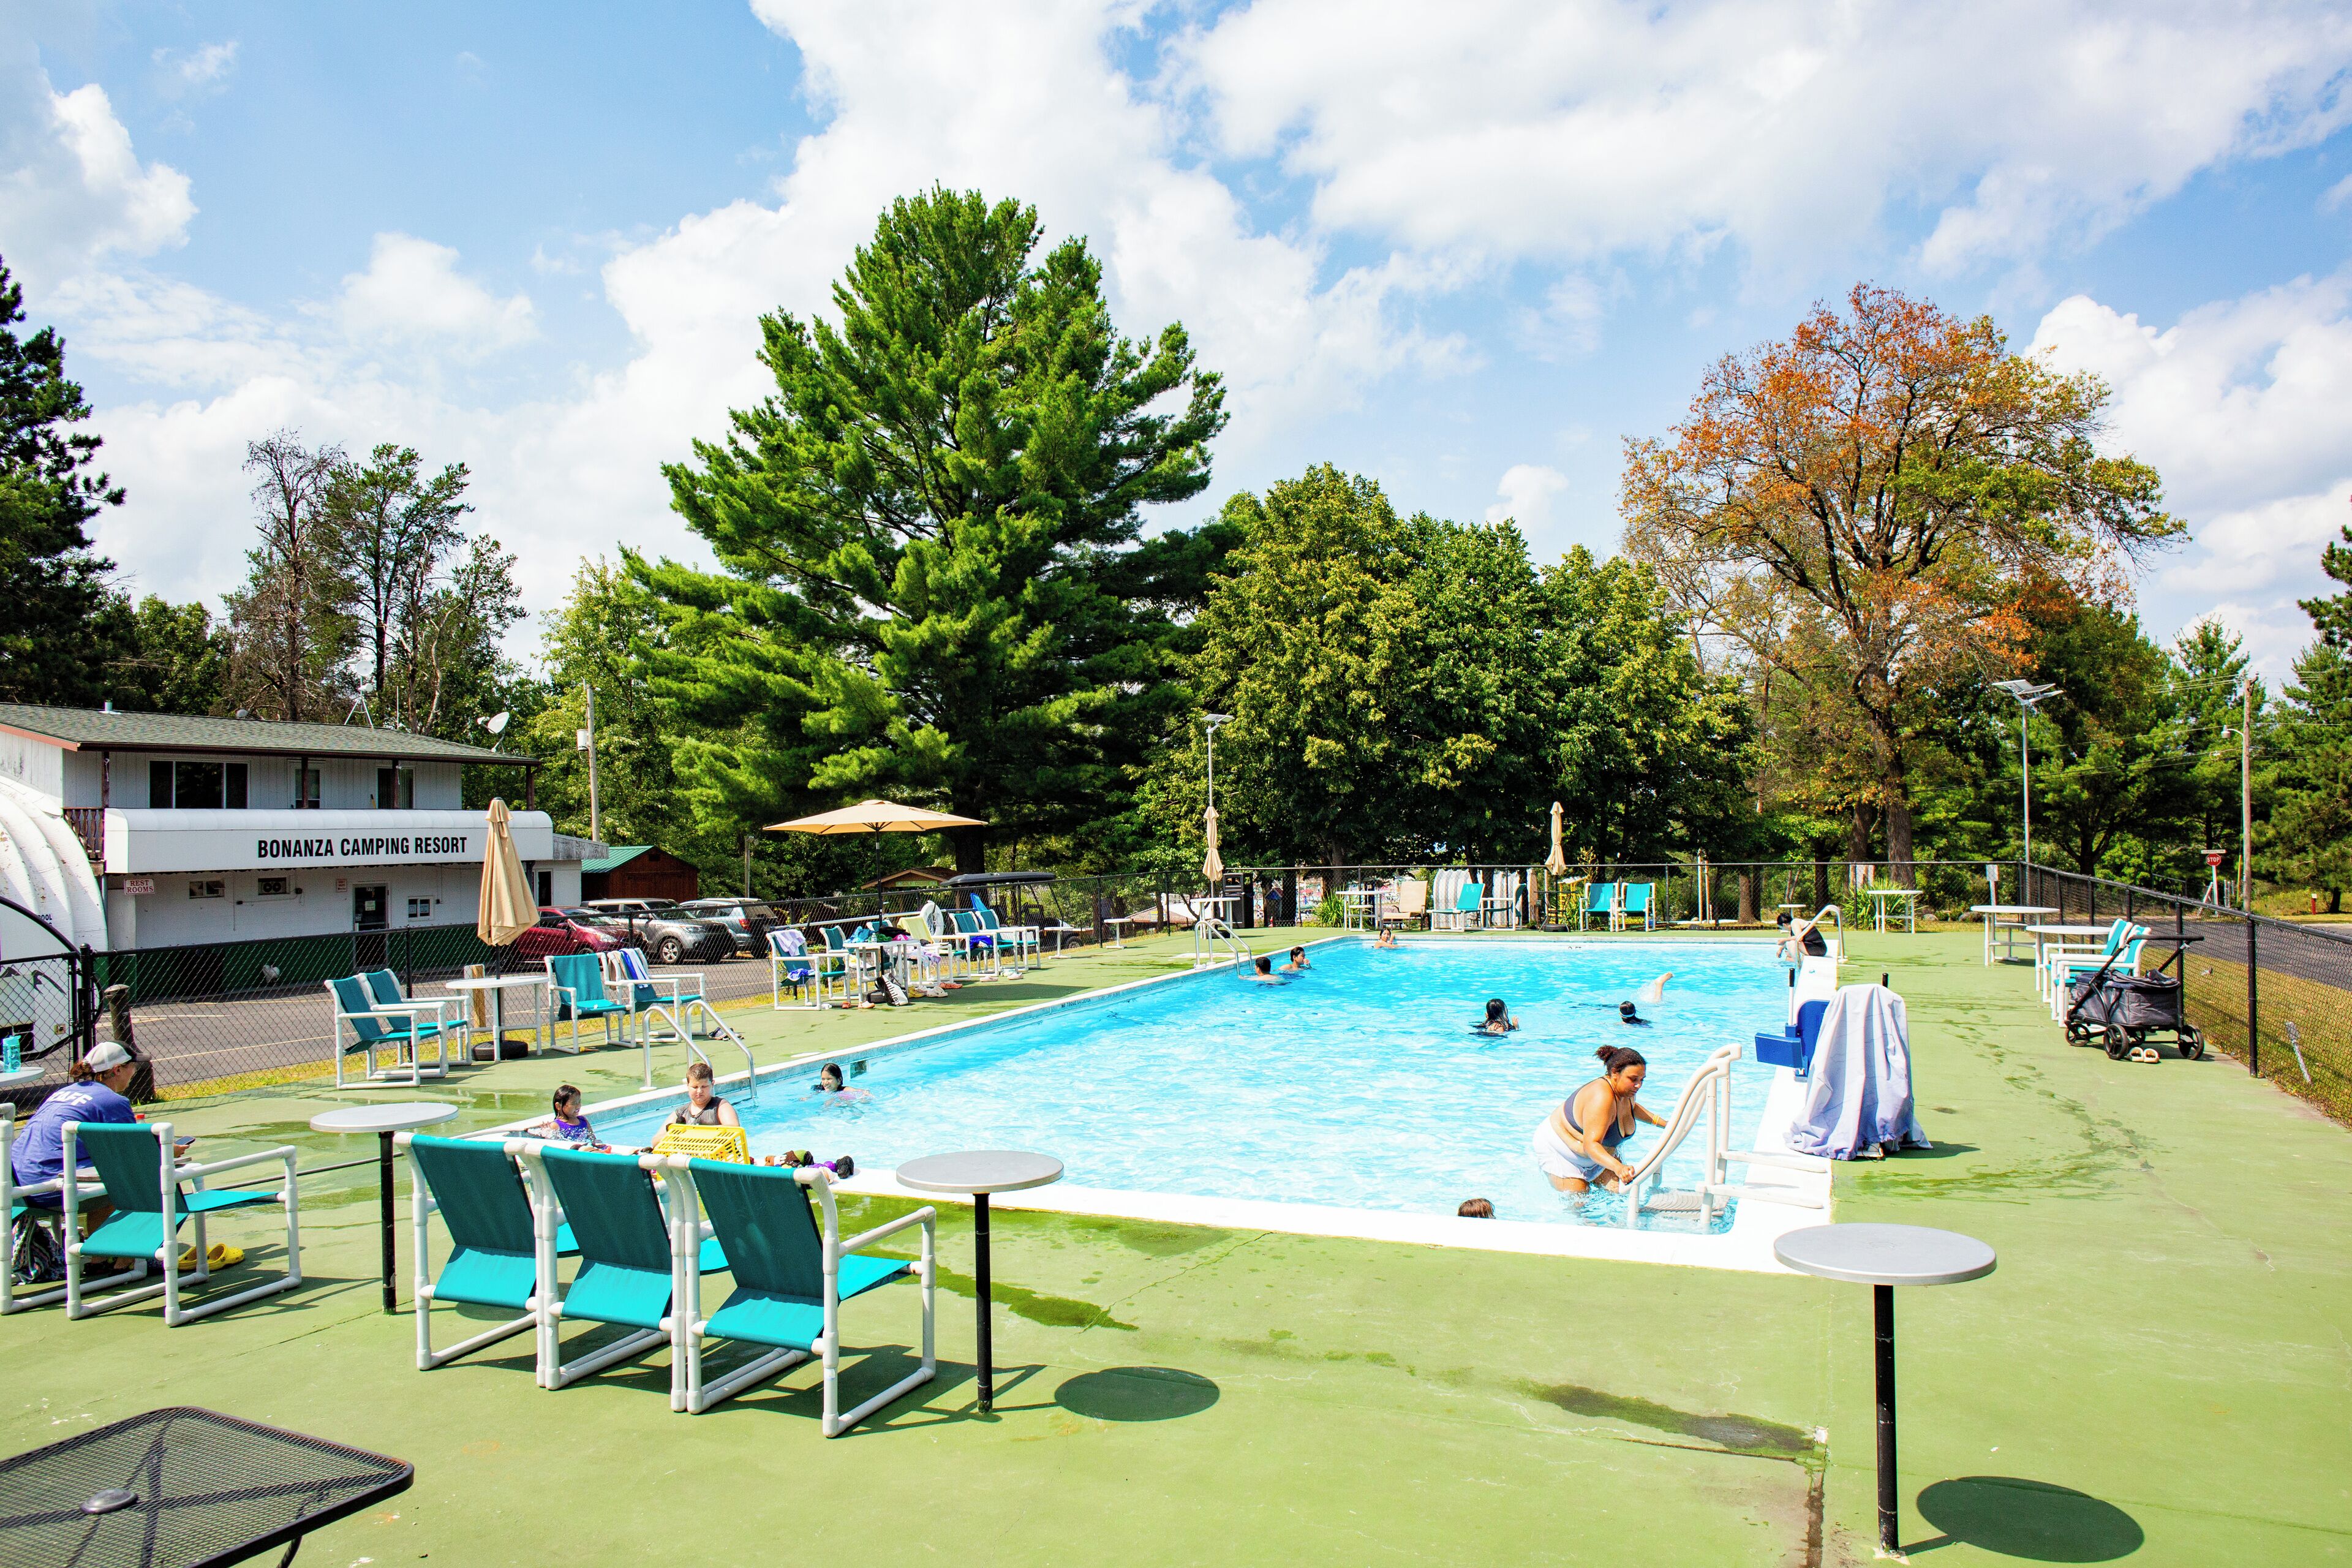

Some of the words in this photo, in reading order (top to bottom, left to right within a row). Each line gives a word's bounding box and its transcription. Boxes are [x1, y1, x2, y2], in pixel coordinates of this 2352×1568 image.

[258, 839, 334, 858] BONANZA
[341, 837, 409, 856] CAMPING
[415, 837, 467, 853] RESORT
